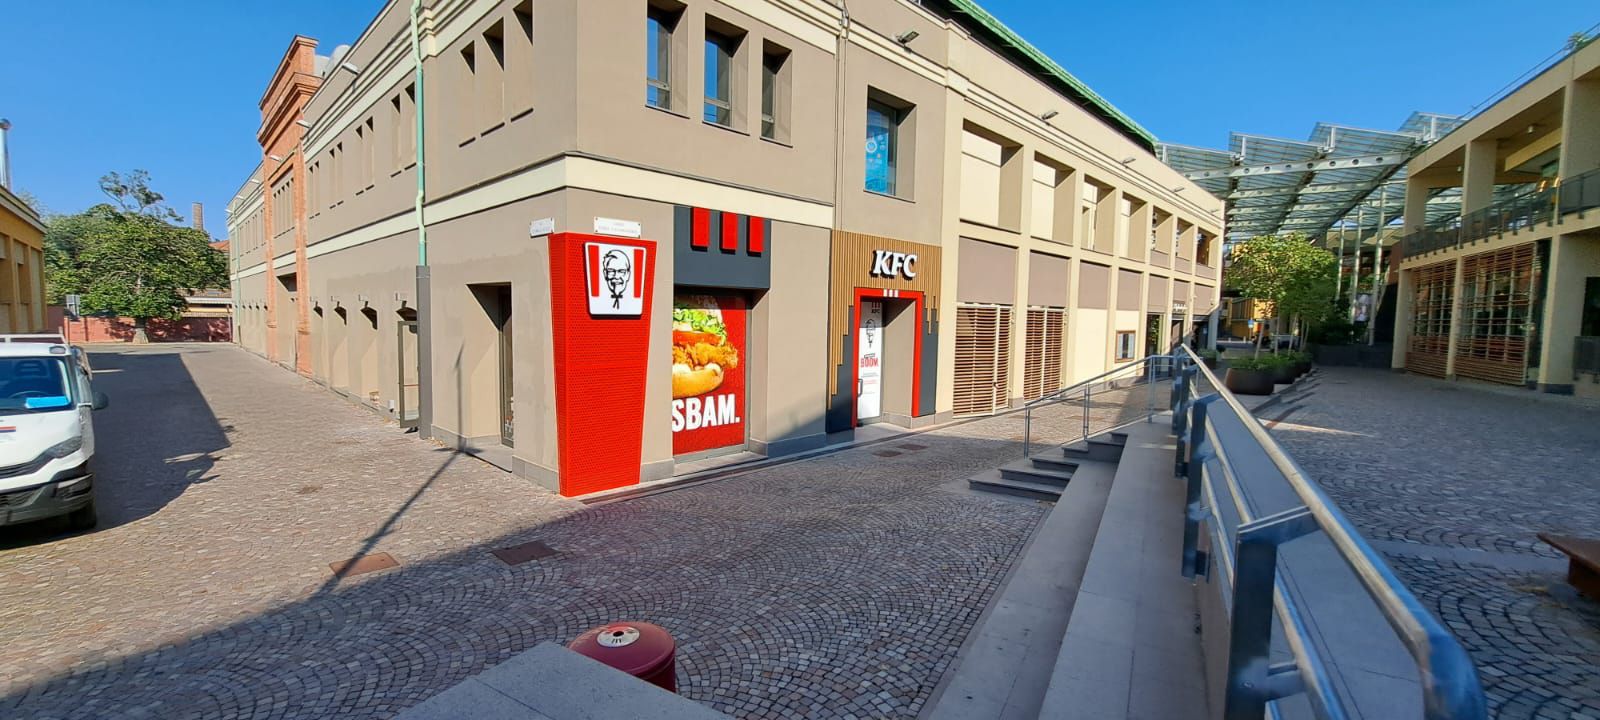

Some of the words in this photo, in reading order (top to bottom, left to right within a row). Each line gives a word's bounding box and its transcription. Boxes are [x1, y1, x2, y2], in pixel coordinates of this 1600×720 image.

[873, 250, 918, 278] KFC
[860, 357, 879, 367] BOOM
[672, 393, 741, 432] SBAM.
